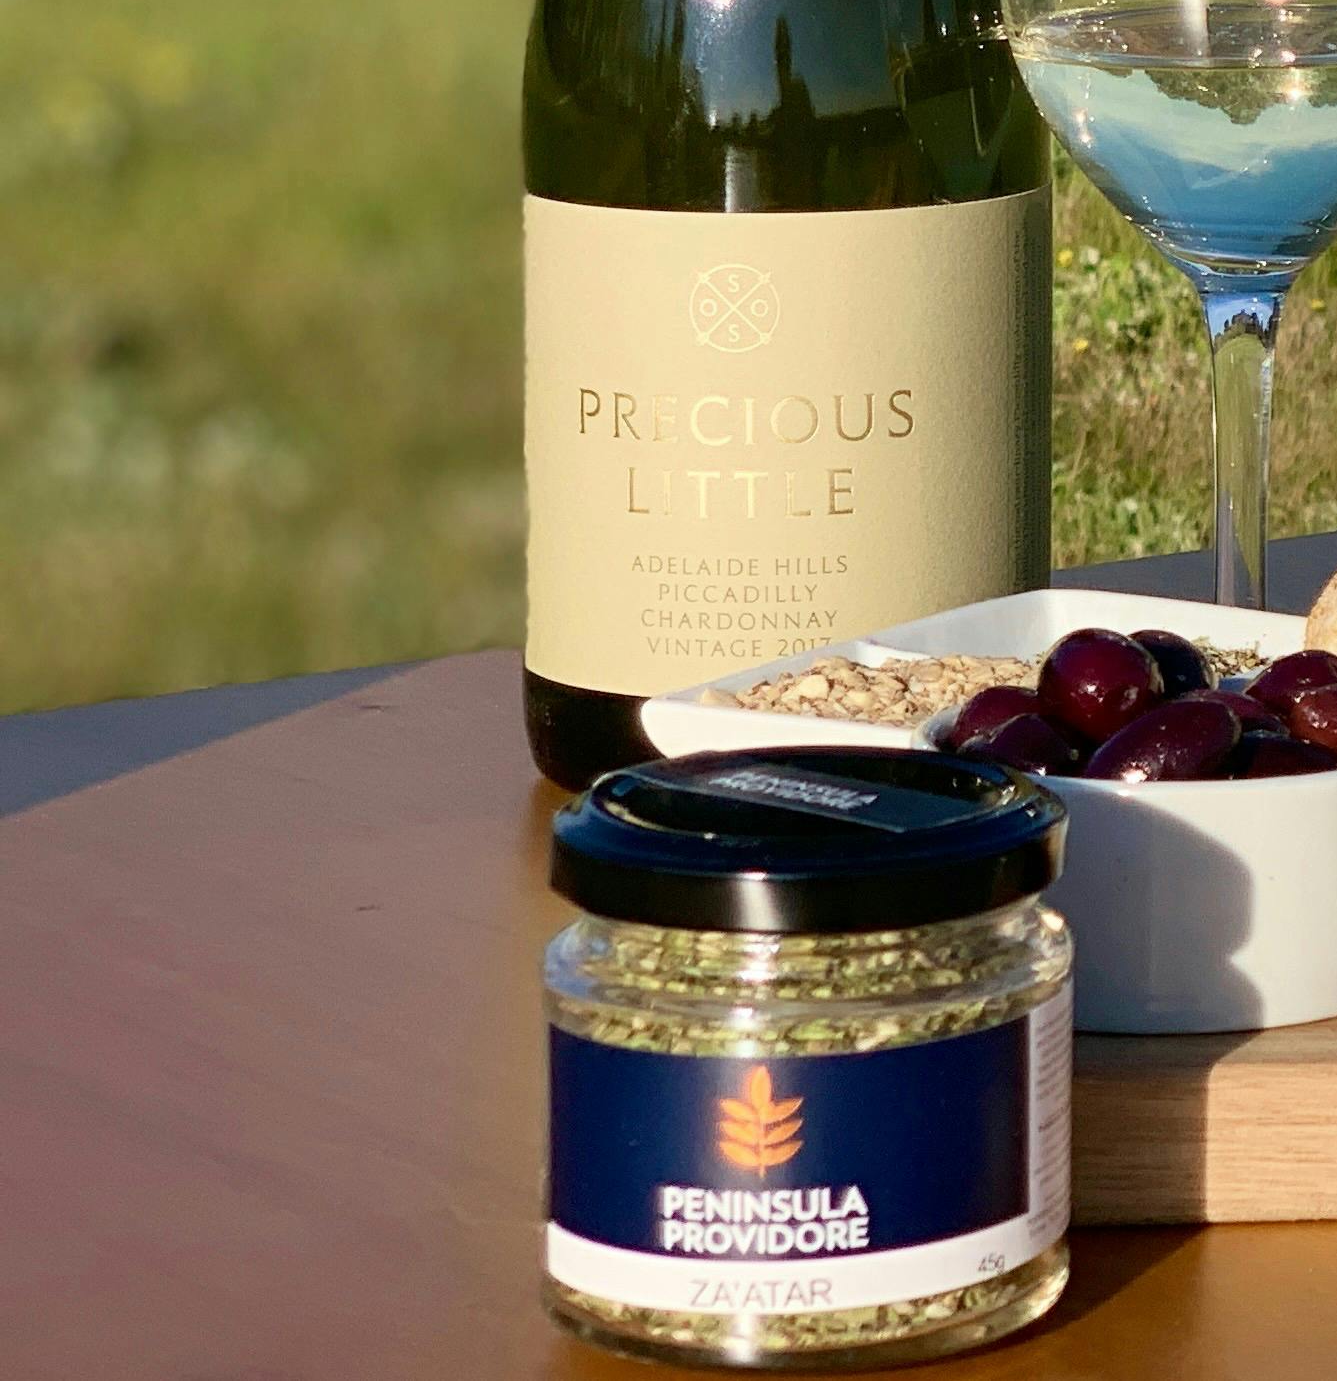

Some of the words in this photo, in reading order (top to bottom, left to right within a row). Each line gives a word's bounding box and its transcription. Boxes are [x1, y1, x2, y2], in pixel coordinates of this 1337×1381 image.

[578, 388, 916, 446] PRECIOUS
[627, 466, 856, 519] LITTLE
[631, 555, 760, 576] ADELAIDE
[775, 555, 848, 576] HILLS
[659, 583, 818, 604] PICCADILLY
[640, 608, 838, 631] CHARDONNAY
[647, 637, 762, 658] VINTAGE
[661, 1184, 869, 1222] PENINSULA
[663, 1217, 871, 1255] PROVIDORE
[689, 1278, 833, 1309] ZA'ATAR
